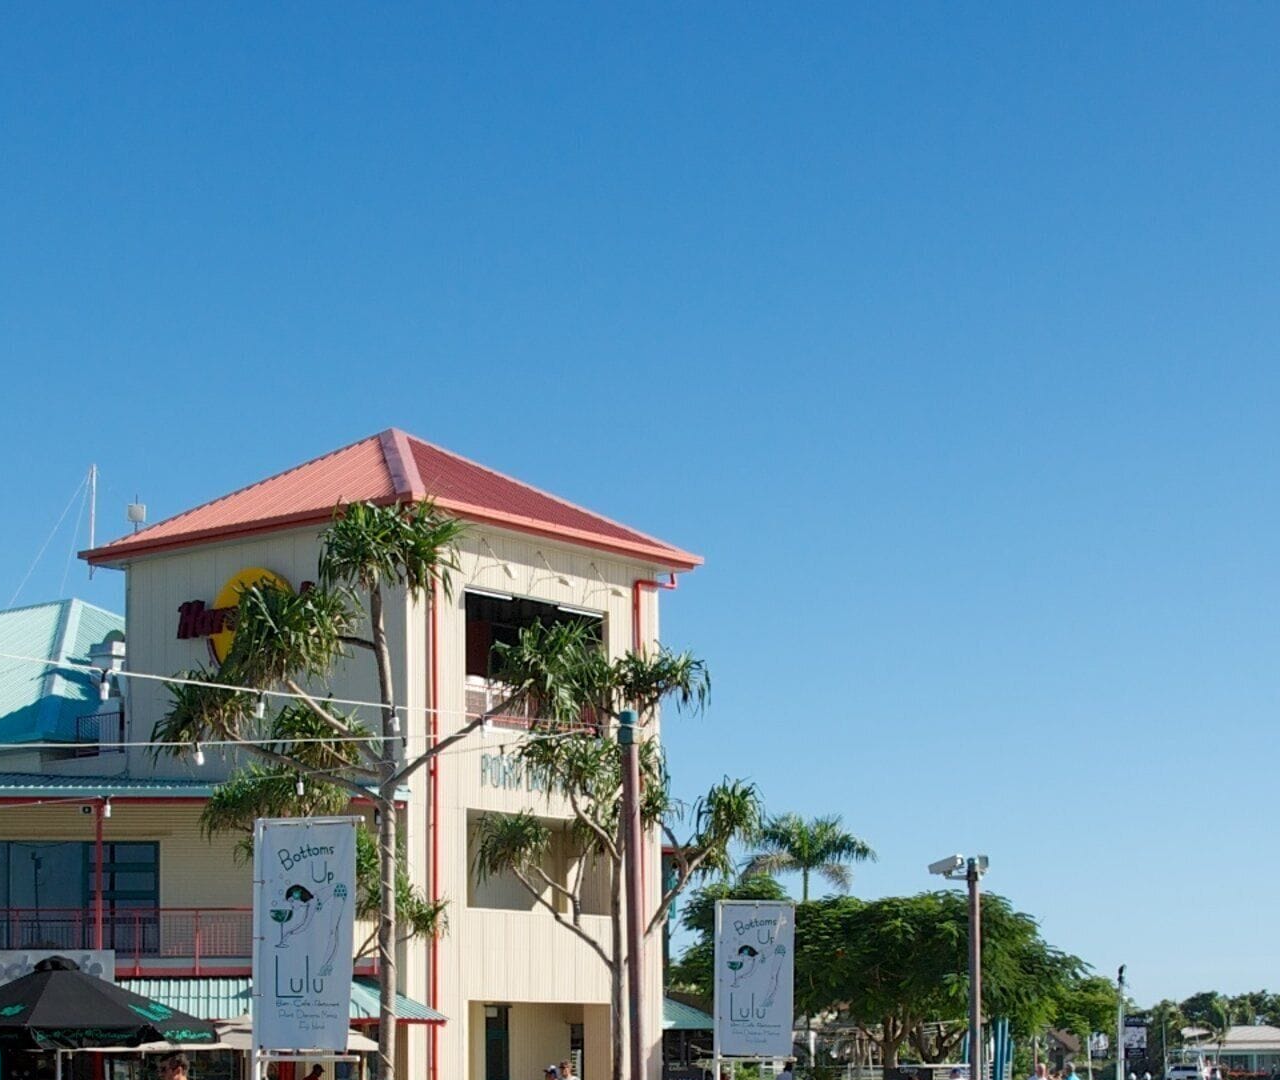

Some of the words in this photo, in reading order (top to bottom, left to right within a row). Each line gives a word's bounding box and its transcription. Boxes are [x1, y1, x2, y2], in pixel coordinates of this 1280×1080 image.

[277, 844, 335, 872] Bottoms
[311, 861, 334, 884] Up
[733, 918, 778, 936] Bottoms
[275, 955, 324, 998] Lulu
[730, 992, 766, 1022] Lulu
